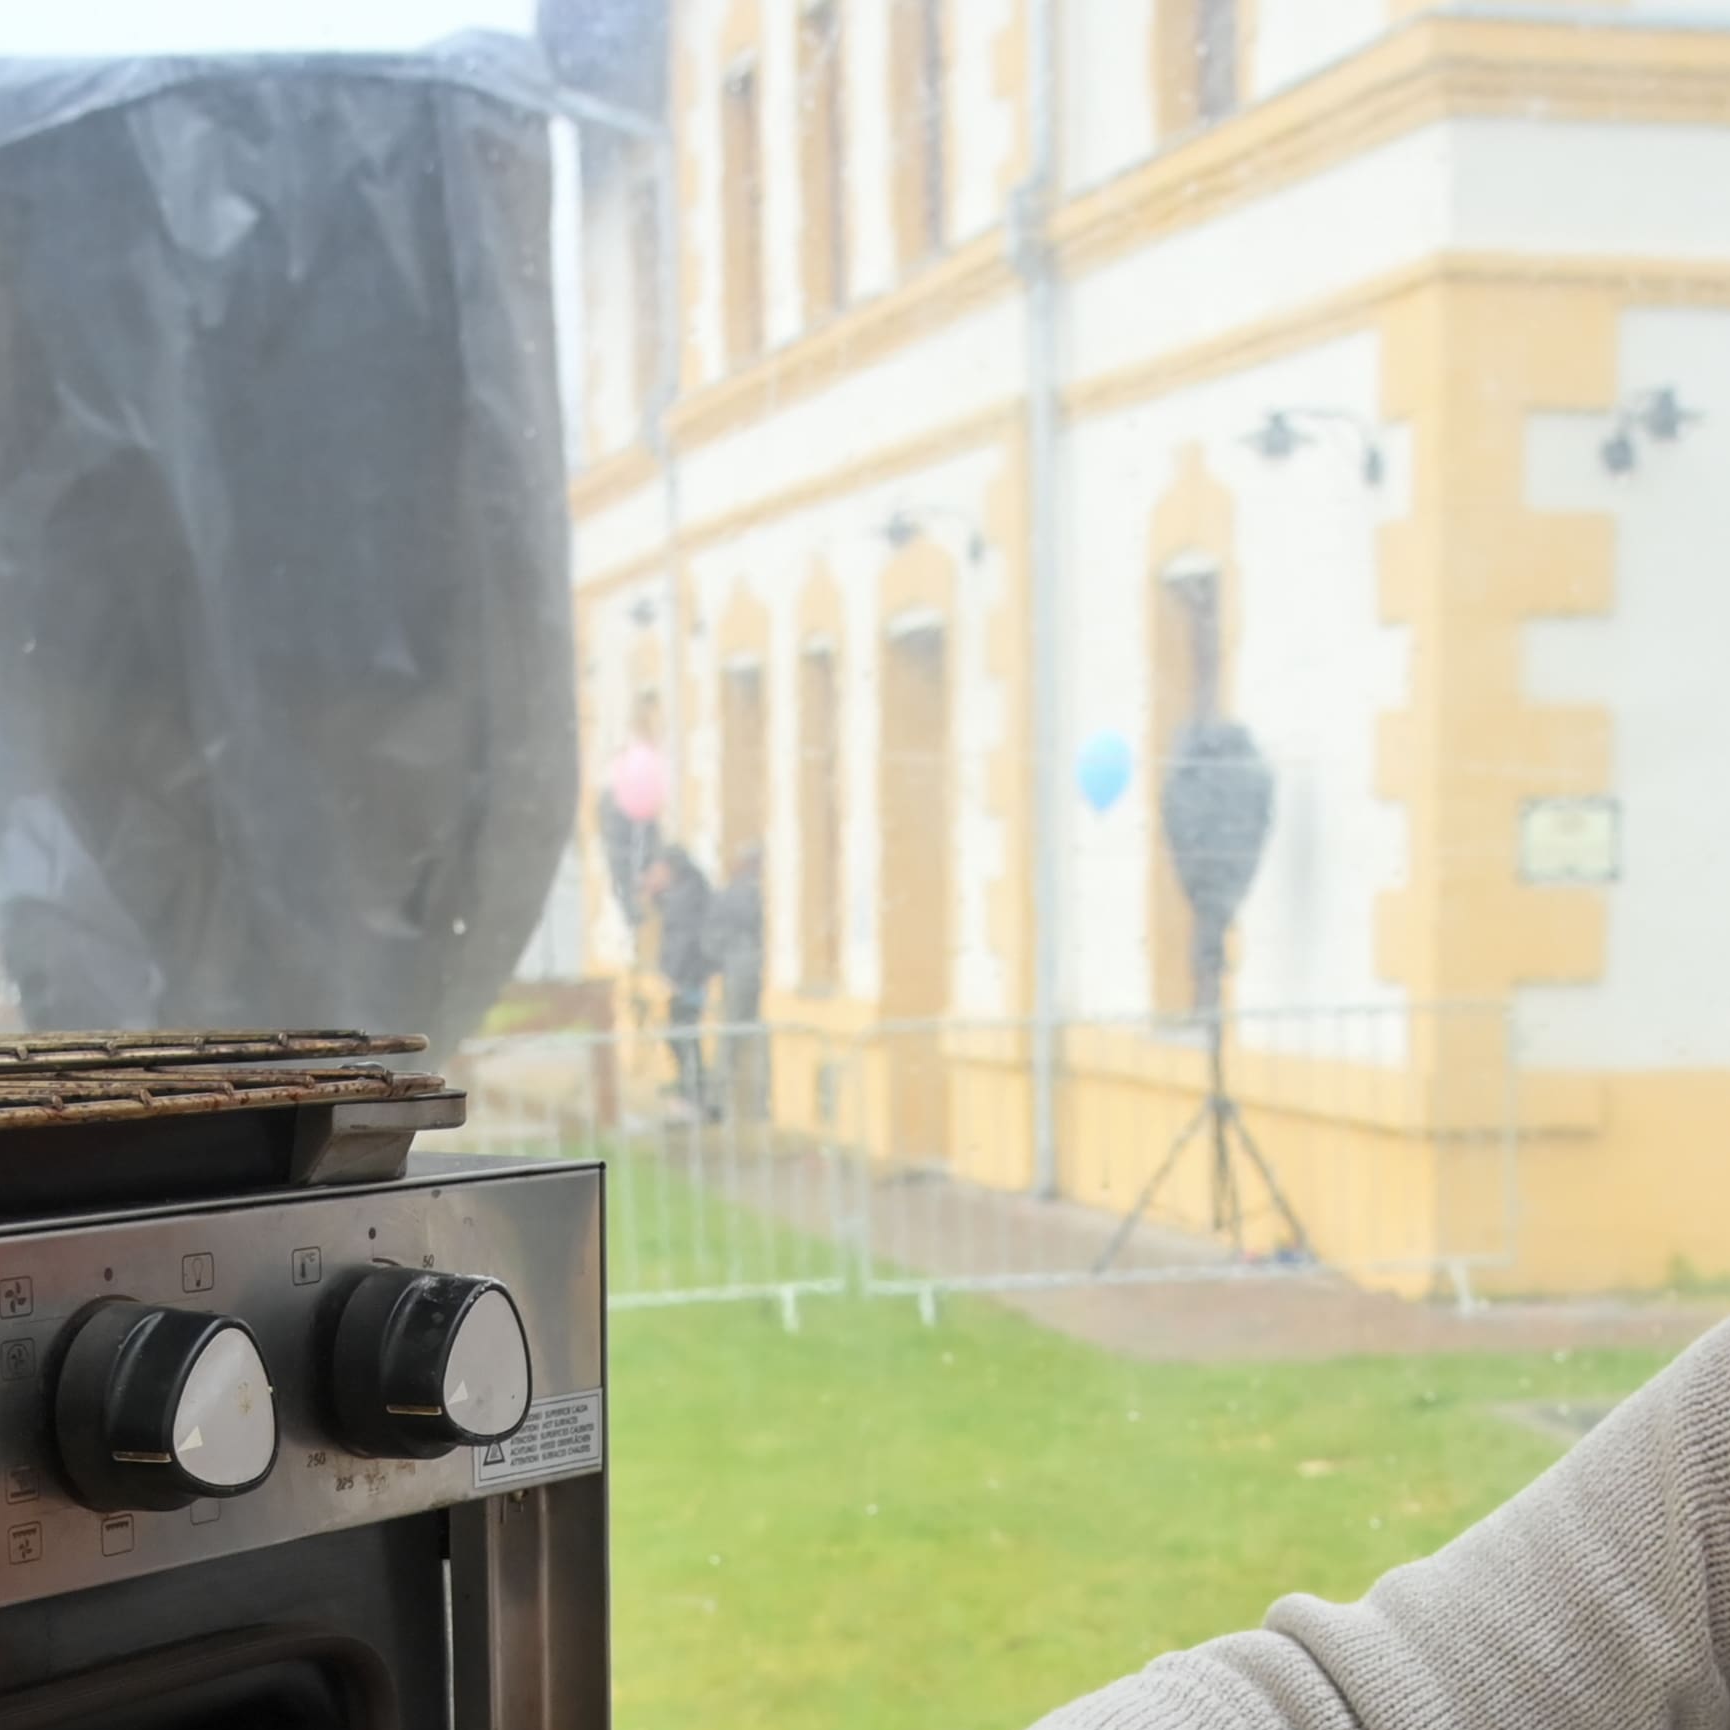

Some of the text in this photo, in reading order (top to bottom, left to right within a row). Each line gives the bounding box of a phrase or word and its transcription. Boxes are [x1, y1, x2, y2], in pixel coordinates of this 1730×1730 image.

[422, 1254, 435, 1268] 50
[306, 1451, 326, 1468] 250
[335, 1476, 354, 1492] 225
